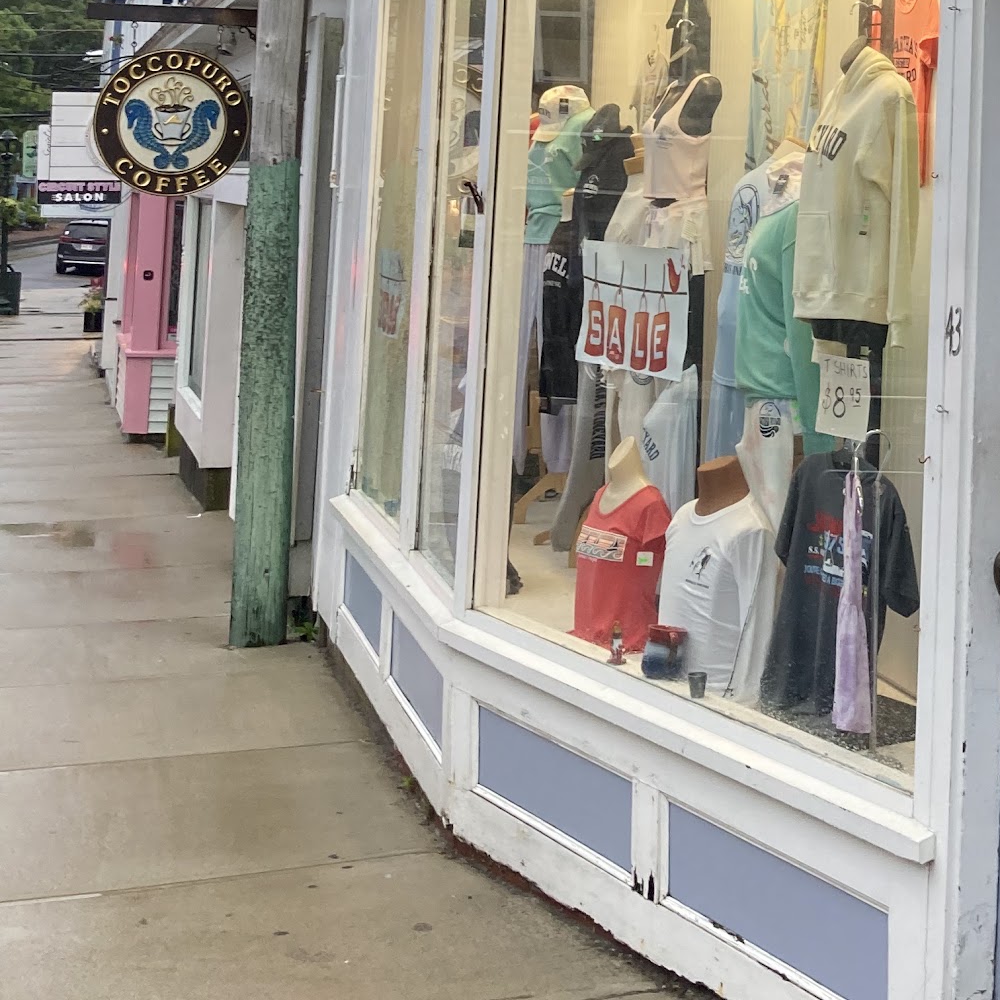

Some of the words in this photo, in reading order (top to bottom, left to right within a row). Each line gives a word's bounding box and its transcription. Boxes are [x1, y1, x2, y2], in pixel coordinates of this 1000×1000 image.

[102, 53, 242, 107] TOCCOPURO
[115, 157, 228, 193] COFFEE
[55, 192, 104, 202] SALON
[589, 309, 667, 360] SALE
[833, 360, 868, 378] SHIRTS
